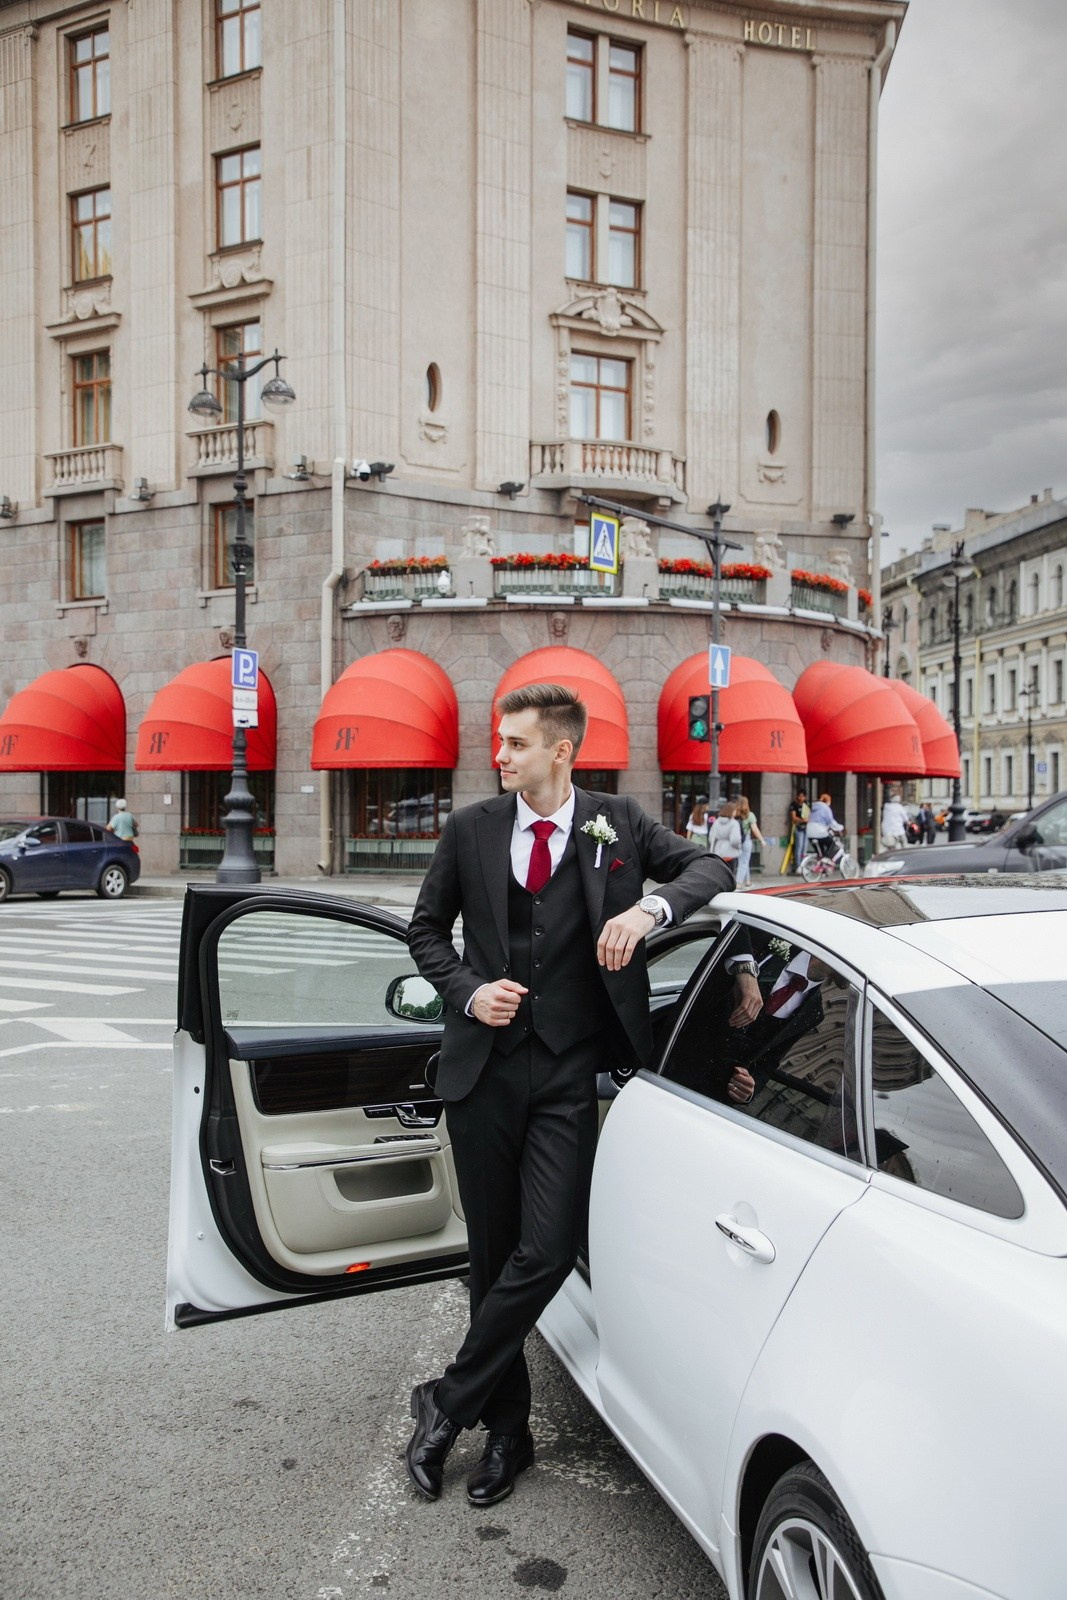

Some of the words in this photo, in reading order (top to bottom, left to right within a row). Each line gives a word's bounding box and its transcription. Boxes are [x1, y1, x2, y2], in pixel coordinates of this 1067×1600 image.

[586, 0, 685, 28] ORIA
[744, 20, 816, 51] HOTEL
[239, 653, 254, 683] P
